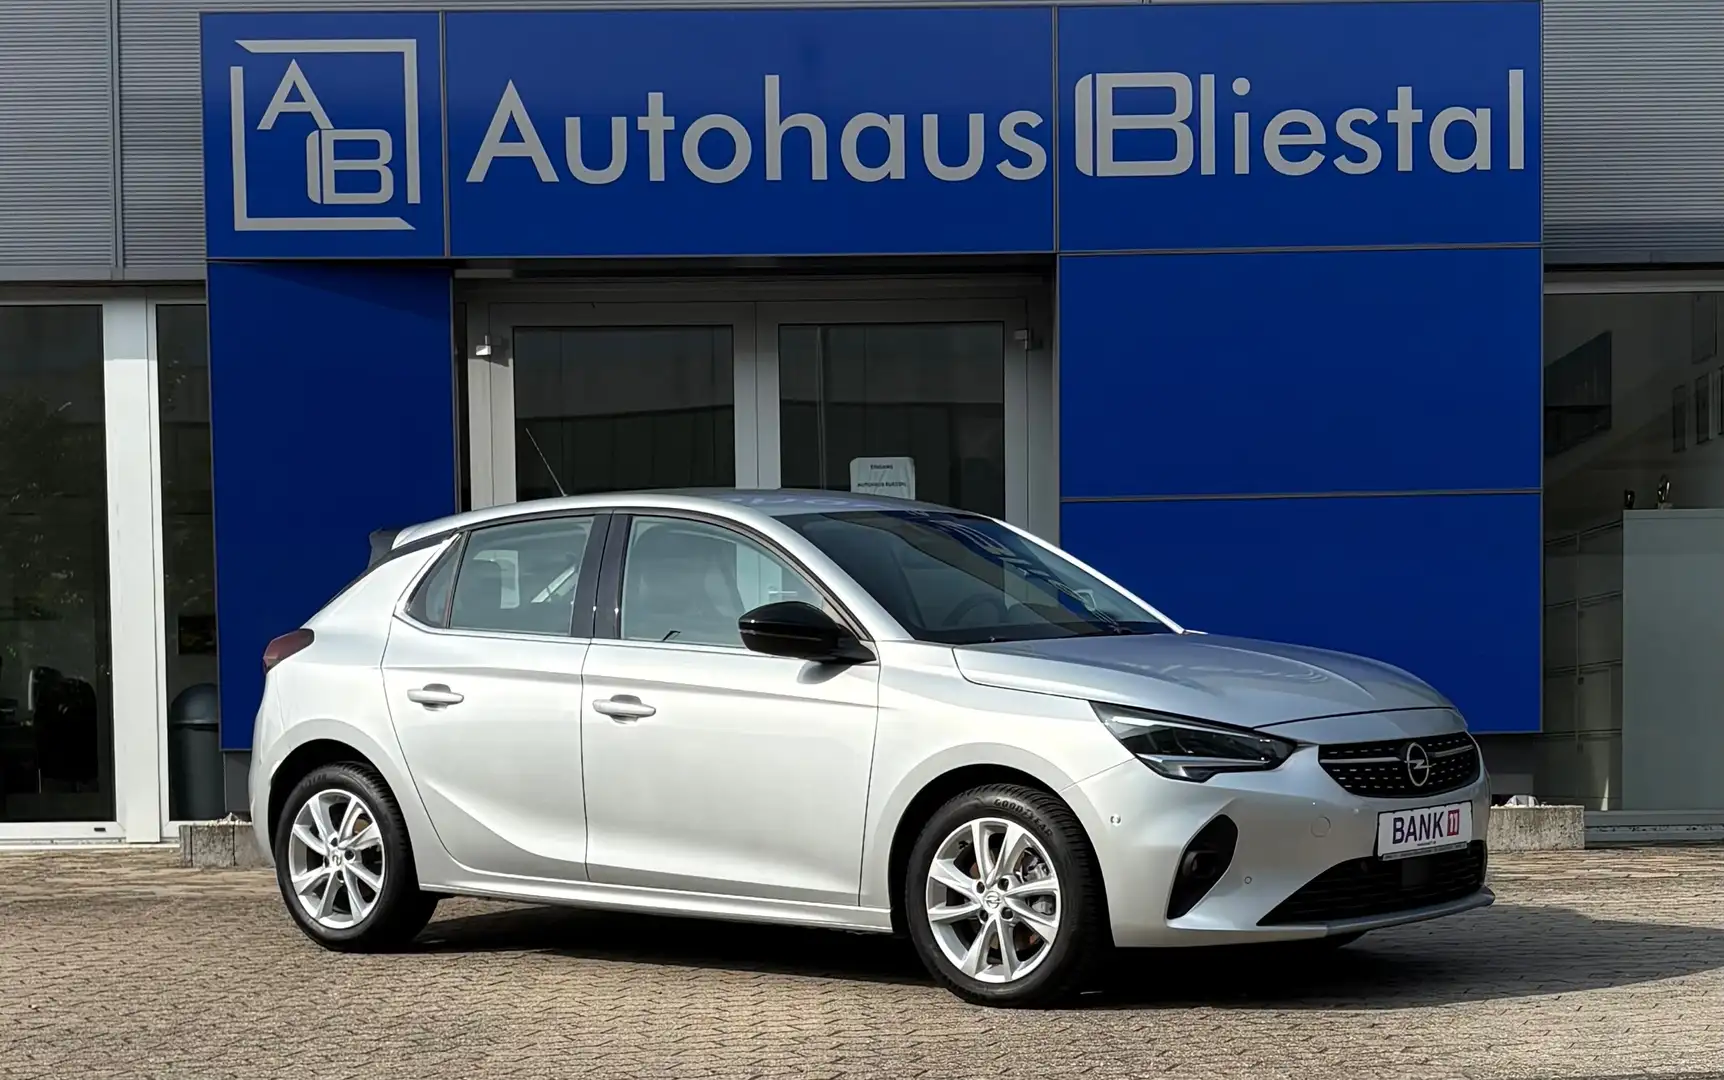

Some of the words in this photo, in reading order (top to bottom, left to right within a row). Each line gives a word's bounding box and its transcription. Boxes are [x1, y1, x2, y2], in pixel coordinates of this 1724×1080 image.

[466, 74, 1047, 184] Autohaus
[1074, 69, 1525, 178] Bliestal
[994, 798, 1053, 837] GOODYEAR
[1392, 811, 1445, 845] BANK
